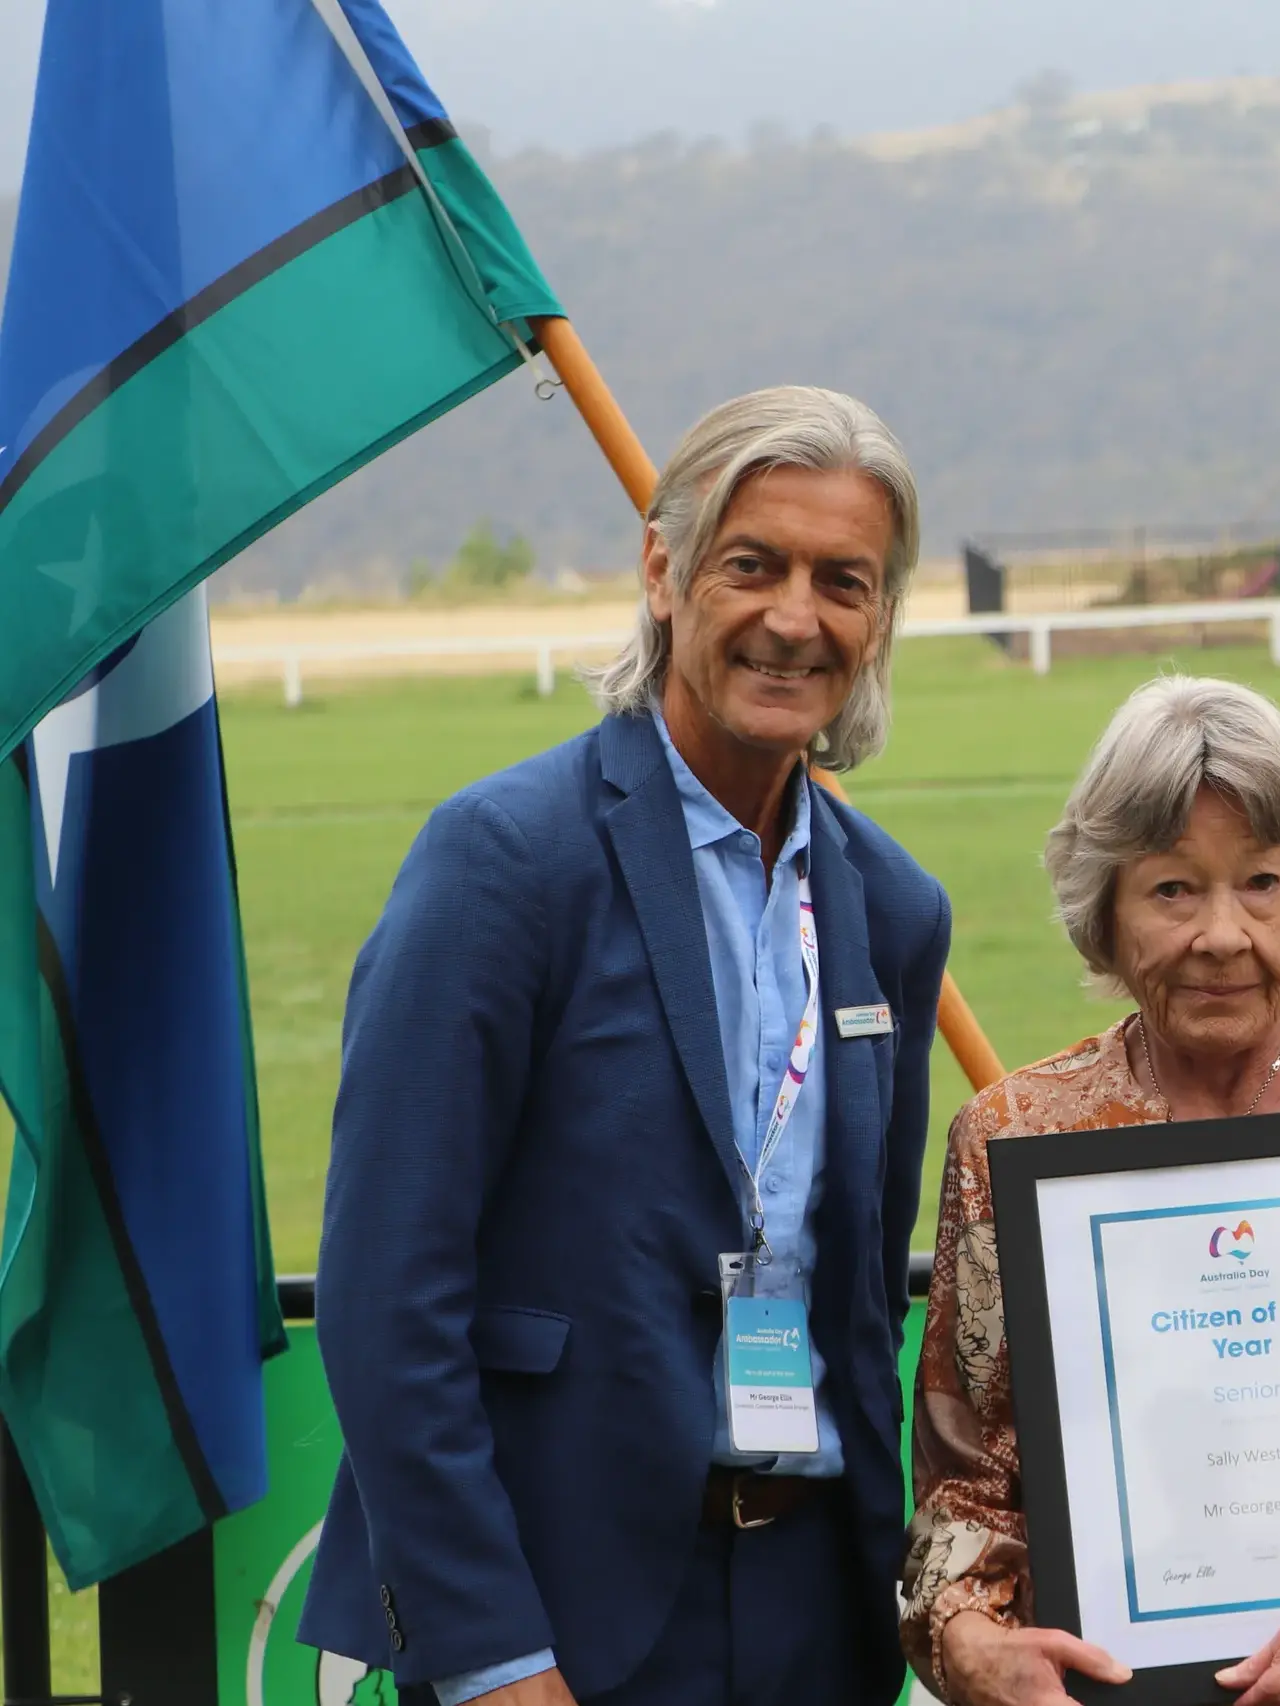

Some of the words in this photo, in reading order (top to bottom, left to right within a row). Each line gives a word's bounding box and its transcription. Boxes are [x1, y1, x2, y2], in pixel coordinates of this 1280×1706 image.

[1200, 1270, 1246, 1283] Australia
[1249, 1268, 1270, 1279] Day
[1151, 1308, 1242, 1333] Citizen
[1251, 1301, 1277, 1324] of
[1211, 1337, 1273, 1360] Year
[749, 1393, 758, 1401] Mr
[758, 1394, 780, 1402] George
[1213, 1381, 1280, 1403] Senior
[1206, 1451, 1240, 1467] Sally
[1203, 1503, 1224, 1518] Mr
